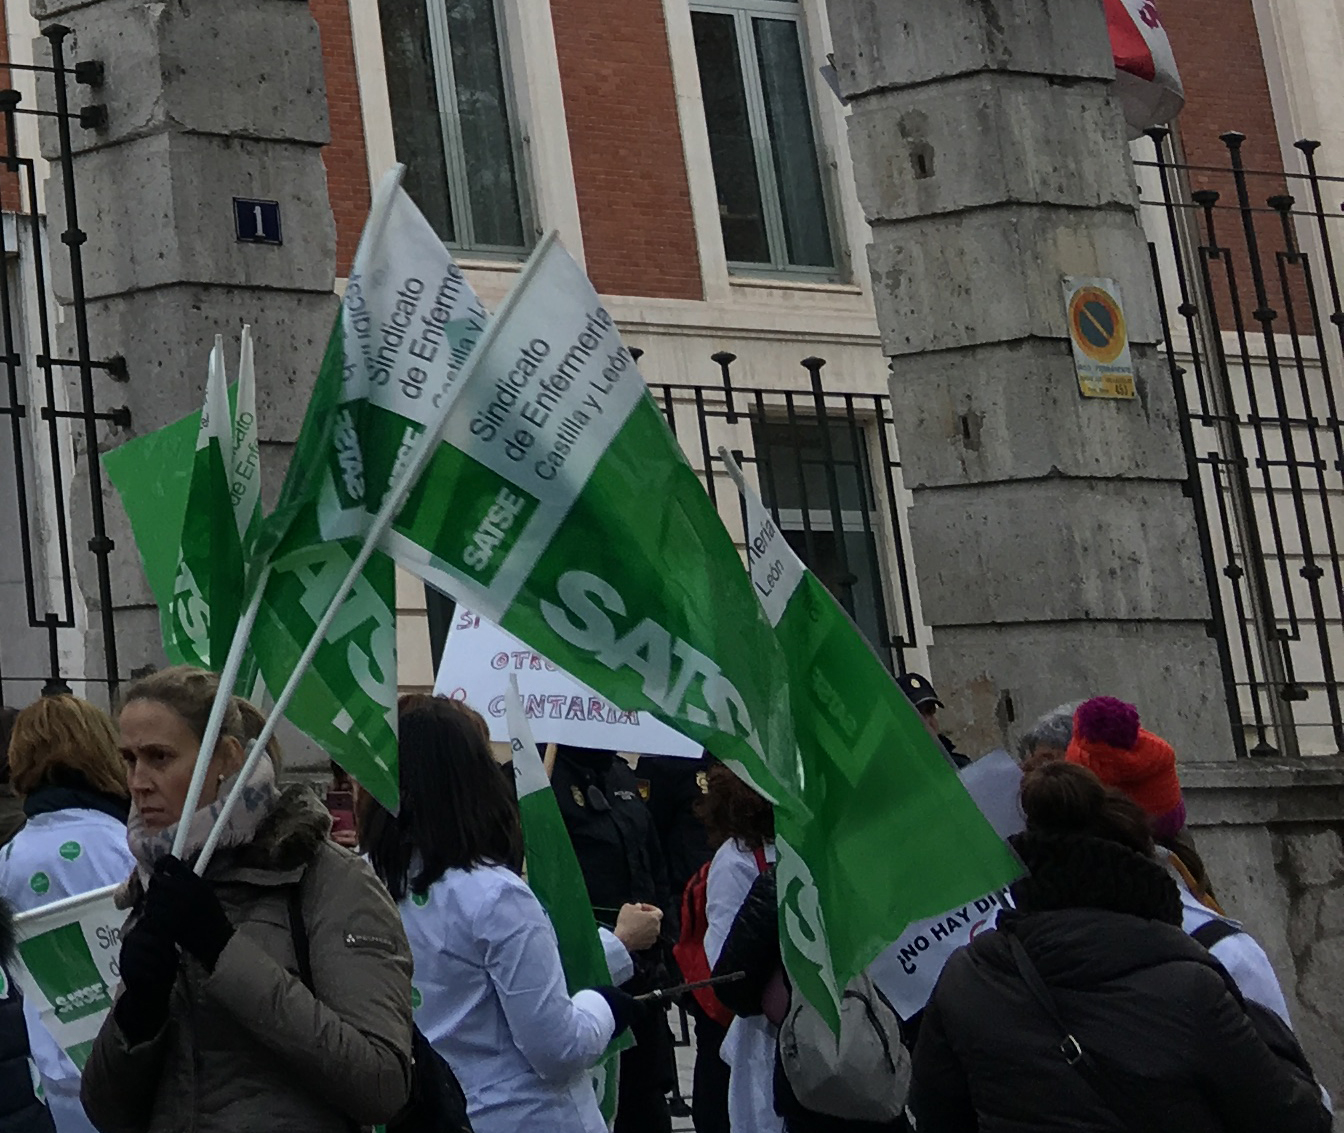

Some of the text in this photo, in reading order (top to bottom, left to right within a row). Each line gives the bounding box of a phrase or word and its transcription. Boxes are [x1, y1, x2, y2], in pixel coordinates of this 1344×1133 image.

[253, 205, 266, 237] 1
[368, 277, 425, 386] Sindicato
[397, 368, 428, 400] de
[470, 338, 552, 443] Sindicato
[505, 429, 536, 463] de
[535, 410, 592, 481] Castilla
[583, 393, 605, 415] y
[463, 487, 527, 572] SATSE
[488, 694, 641, 726] CNTARIA
[930, 907, 971, 941] HAY
